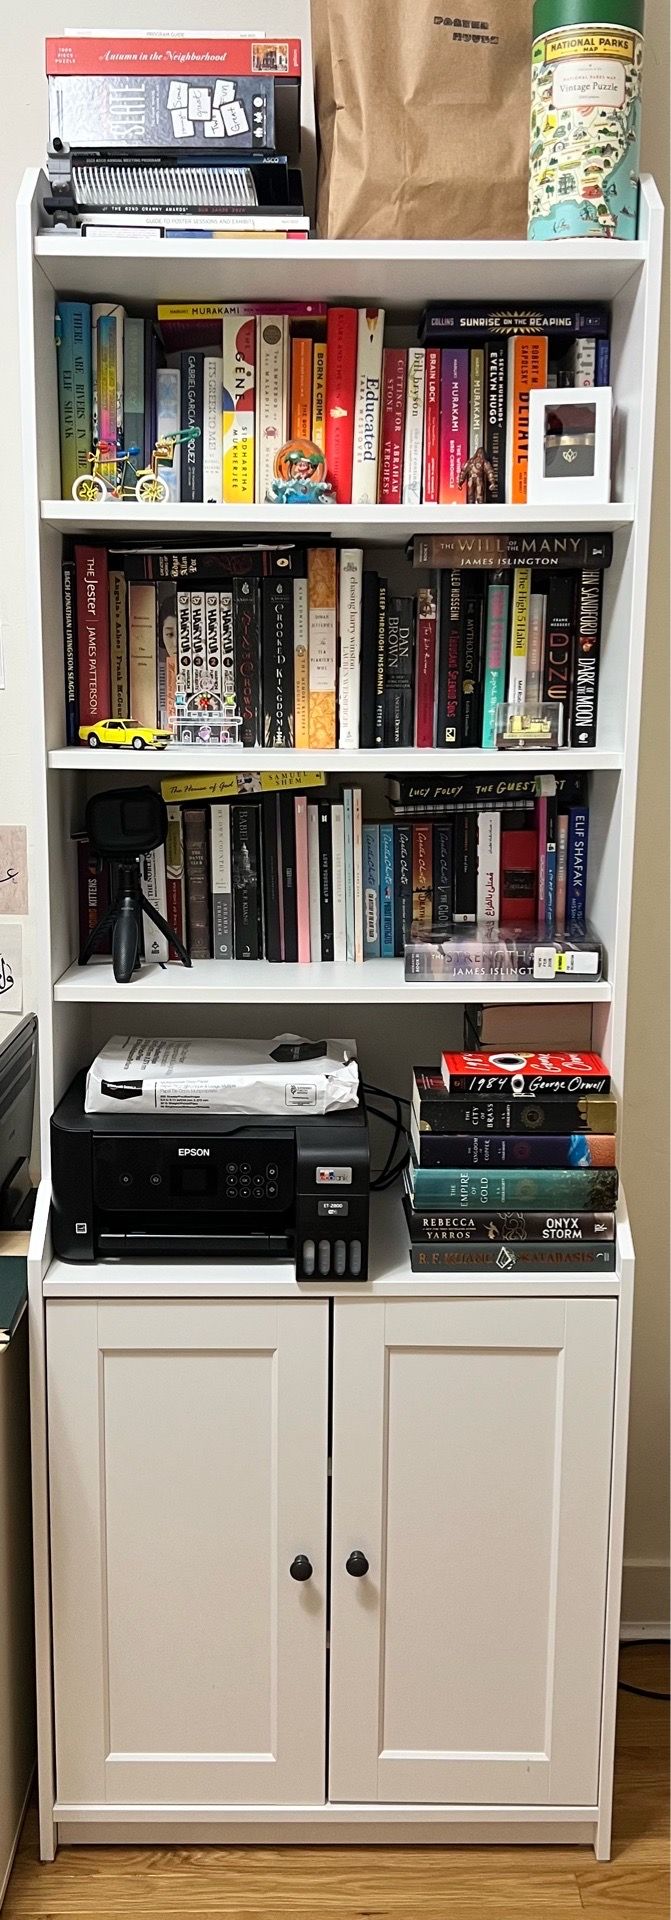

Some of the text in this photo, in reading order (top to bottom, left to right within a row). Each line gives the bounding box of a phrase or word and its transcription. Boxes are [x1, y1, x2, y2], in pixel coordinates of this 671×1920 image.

[99, 50, 227, 62] Autumn in the Neighborhood
[551, 38, 629, 52] NATIONAL PARKS
[560, 82, 618, 93] Vintage Puzzle
[227, 107, 241, 133] Great
[191, 306, 240, 315] MURAKAMI
[431, 317, 454, 326] COLLINS
[460, 317, 500, 326] SUNRISE
[529, 317, 572, 326] REAPING
[187, 355, 197, 389] GABRIEL
[429, 353, 437, 379] BRAIN
[521, 345, 529, 385] SAPOLSKY
[531, 345, 539, 374] ROBERT
[73, 312, 87, 469] THERE ARE RIVERS IN THE
[234, 351, 245, 401] GENE
[315, 352, 324, 422] BORN A CRIME
[410, 352, 424, 417] bill bryson
[489, 352, 498, 425] EVELYN HUGO
[63, 370, 74, 439] ELIF SHAFAK
[209, 380, 217, 429] GREEK TO
[386, 378, 395, 413] STONE
[394, 359, 405, 432] CUTTING FOR
[428, 381, 436, 403] LOCK
[451, 382, 459, 432] MURAKAMI
[473, 380, 481, 430] MURAKAMI
[362, 377, 380, 461] Educated
[383, 441, 392, 495] VERGHESE
[391, 443, 400, 493] ABRAHAM
[457, 539, 505, 551] WILL
[521, 538, 581, 552] MANY
[460, 557, 559, 566] JAMES ISLINGTON
[518, 569, 528, 590] The
[113, 576, 122, 618] Angela's
[450, 588, 460, 621] HOSSEINI
[516, 590, 527, 614] High
[578, 587, 600, 635] SANDFORD
[83, 558, 99, 715] THE Jester JAMES PATTERSON
[275, 604, 286, 665] CROOKED
[347, 577, 358, 671] chasing harry winston
[516, 624, 526, 649] Habit
[66, 629, 74, 671] LIVINGSTON
[388, 617, 399, 668] BROWN
[399, 627, 410, 657] DAN
[465, 619, 474, 674] MYTHOLOGY
[67, 672, 75, 703] SEAGULL
[275, 668, 284, 733] KINGDOM
[575, 658, 596, 727] DARK MOON
[169, 781, 234, 794] The House of God
[268, 771, 308, 781] SAMUEL
[275, 777, 302, 785] SHEM
[409, 780, 536, 798] LUCY FOLEY THE GUEST
[239, 810, 248, 841] BABEL
[573, 815, 585, 887] ELIF SHAFAK
[88, 878, 98, 907] KITTENS
[452, 967, 486, 977] JAMES
[469, 1076, 606, 1092] 1984 George Orwell
[472, 1106, 480, 1125] CITY
[486, 1103, 494, 1128] BRASS
[178, 1148, 210, 1157] EPSON
[460, 1172, 470, 1207] EMPIRE
[471, 1186, 477, 1195] OF
[480, 1177, 489, 1203] GOLD
[422, 1218, 475, 1227] REBECCA
[426, 1231, 471, 1239] YARROS
[542, 1229, 583, 1239] STORM
[546, 1218, 579, 1228] ONYX
